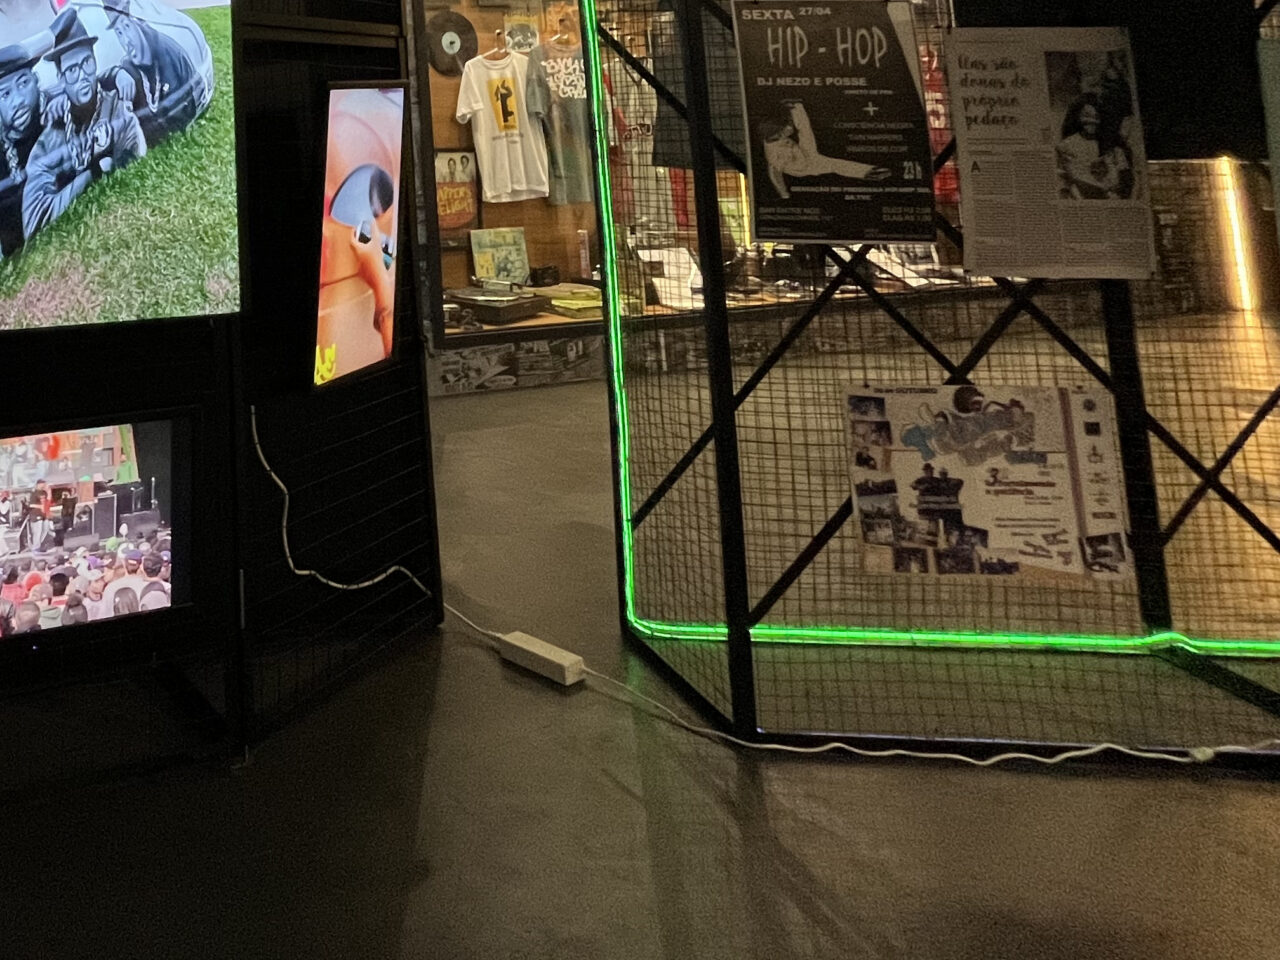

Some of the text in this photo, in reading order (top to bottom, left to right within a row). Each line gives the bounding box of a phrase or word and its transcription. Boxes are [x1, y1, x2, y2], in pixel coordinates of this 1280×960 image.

[740, 8, 796, 21] SEXTA
[767, 25, 809, 69] HIP
[835, 24, 888, 69] HOP
[756, 76, 773, 86] DJ
[813, 77, 822, 86] E
[825, 77, 868, 86] POSSE
